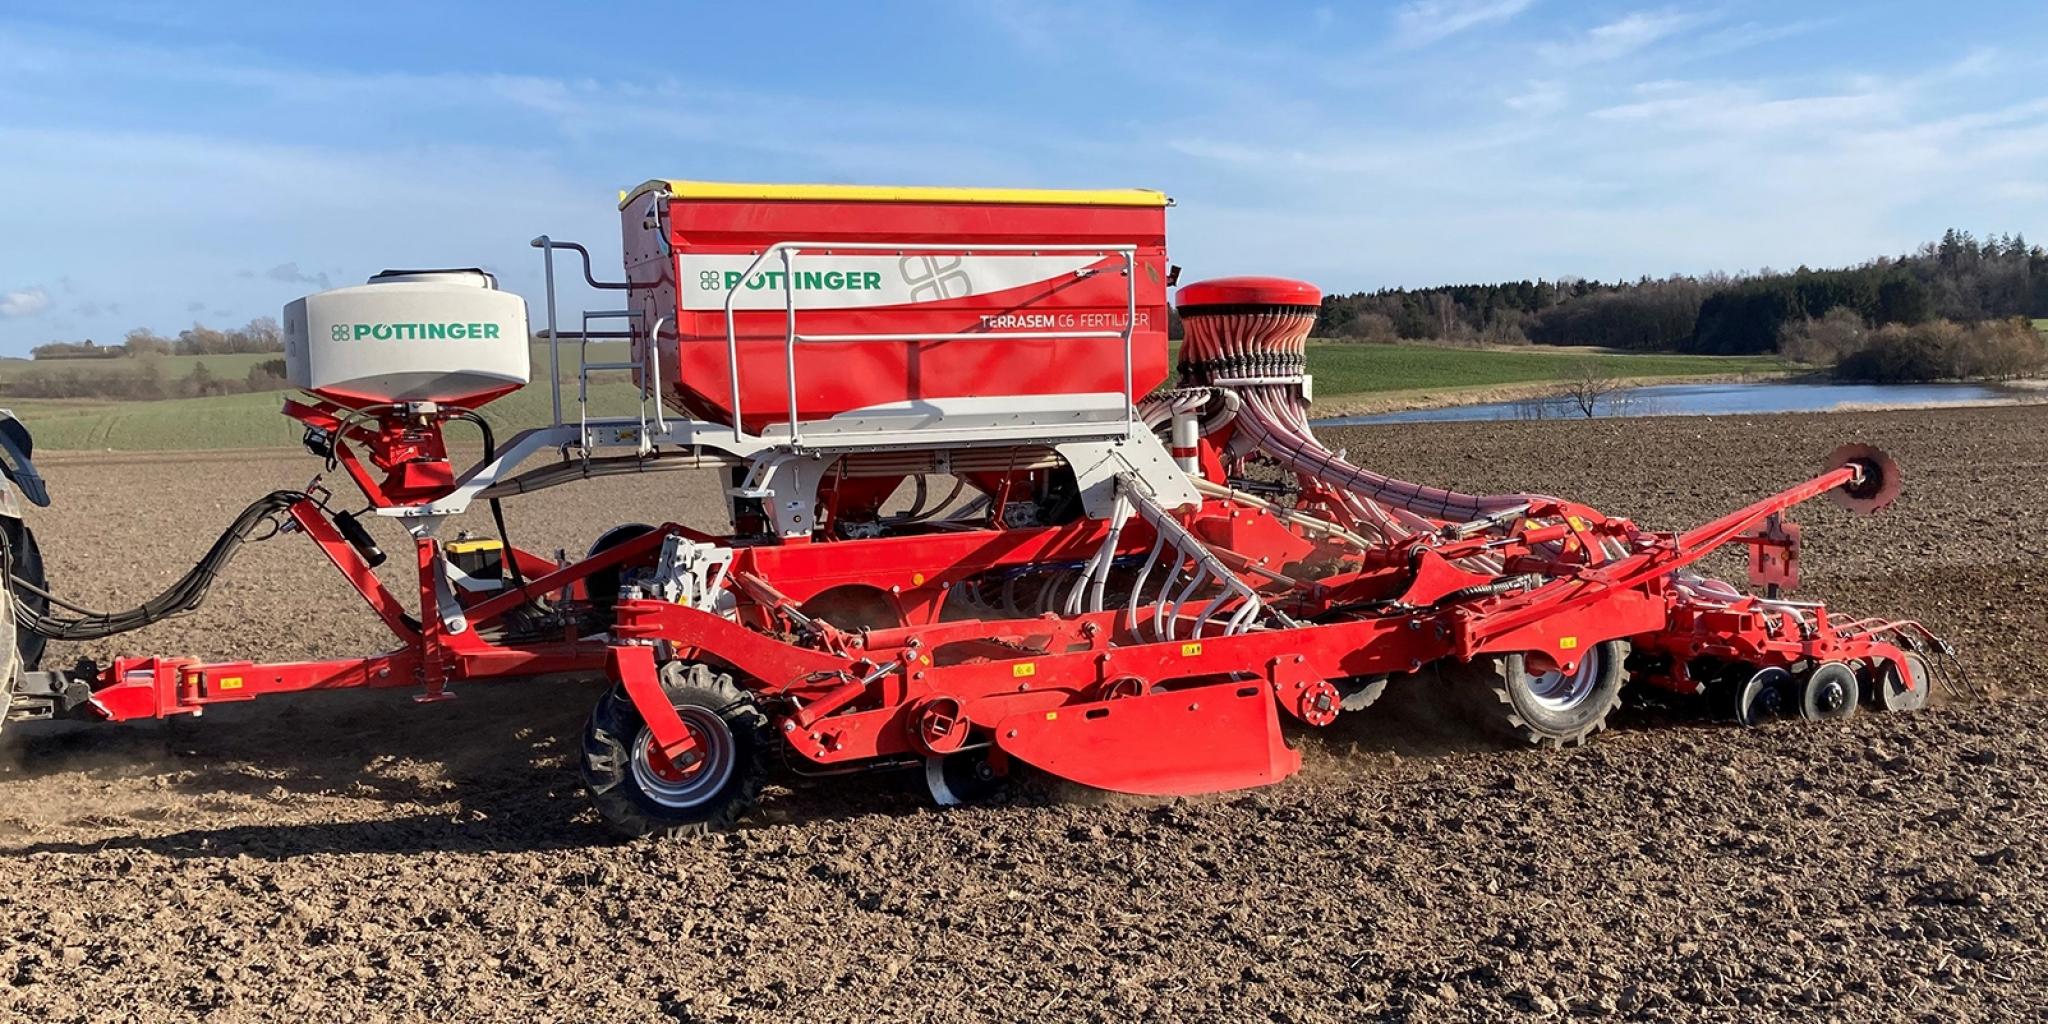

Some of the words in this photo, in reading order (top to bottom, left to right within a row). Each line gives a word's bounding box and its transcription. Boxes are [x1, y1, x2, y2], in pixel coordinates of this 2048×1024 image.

[980, 314, 1055, 329] TERRASEM
[1058, 314, 1074, 328] C6
[354, 323, 500, 341] PÖTTINGER
